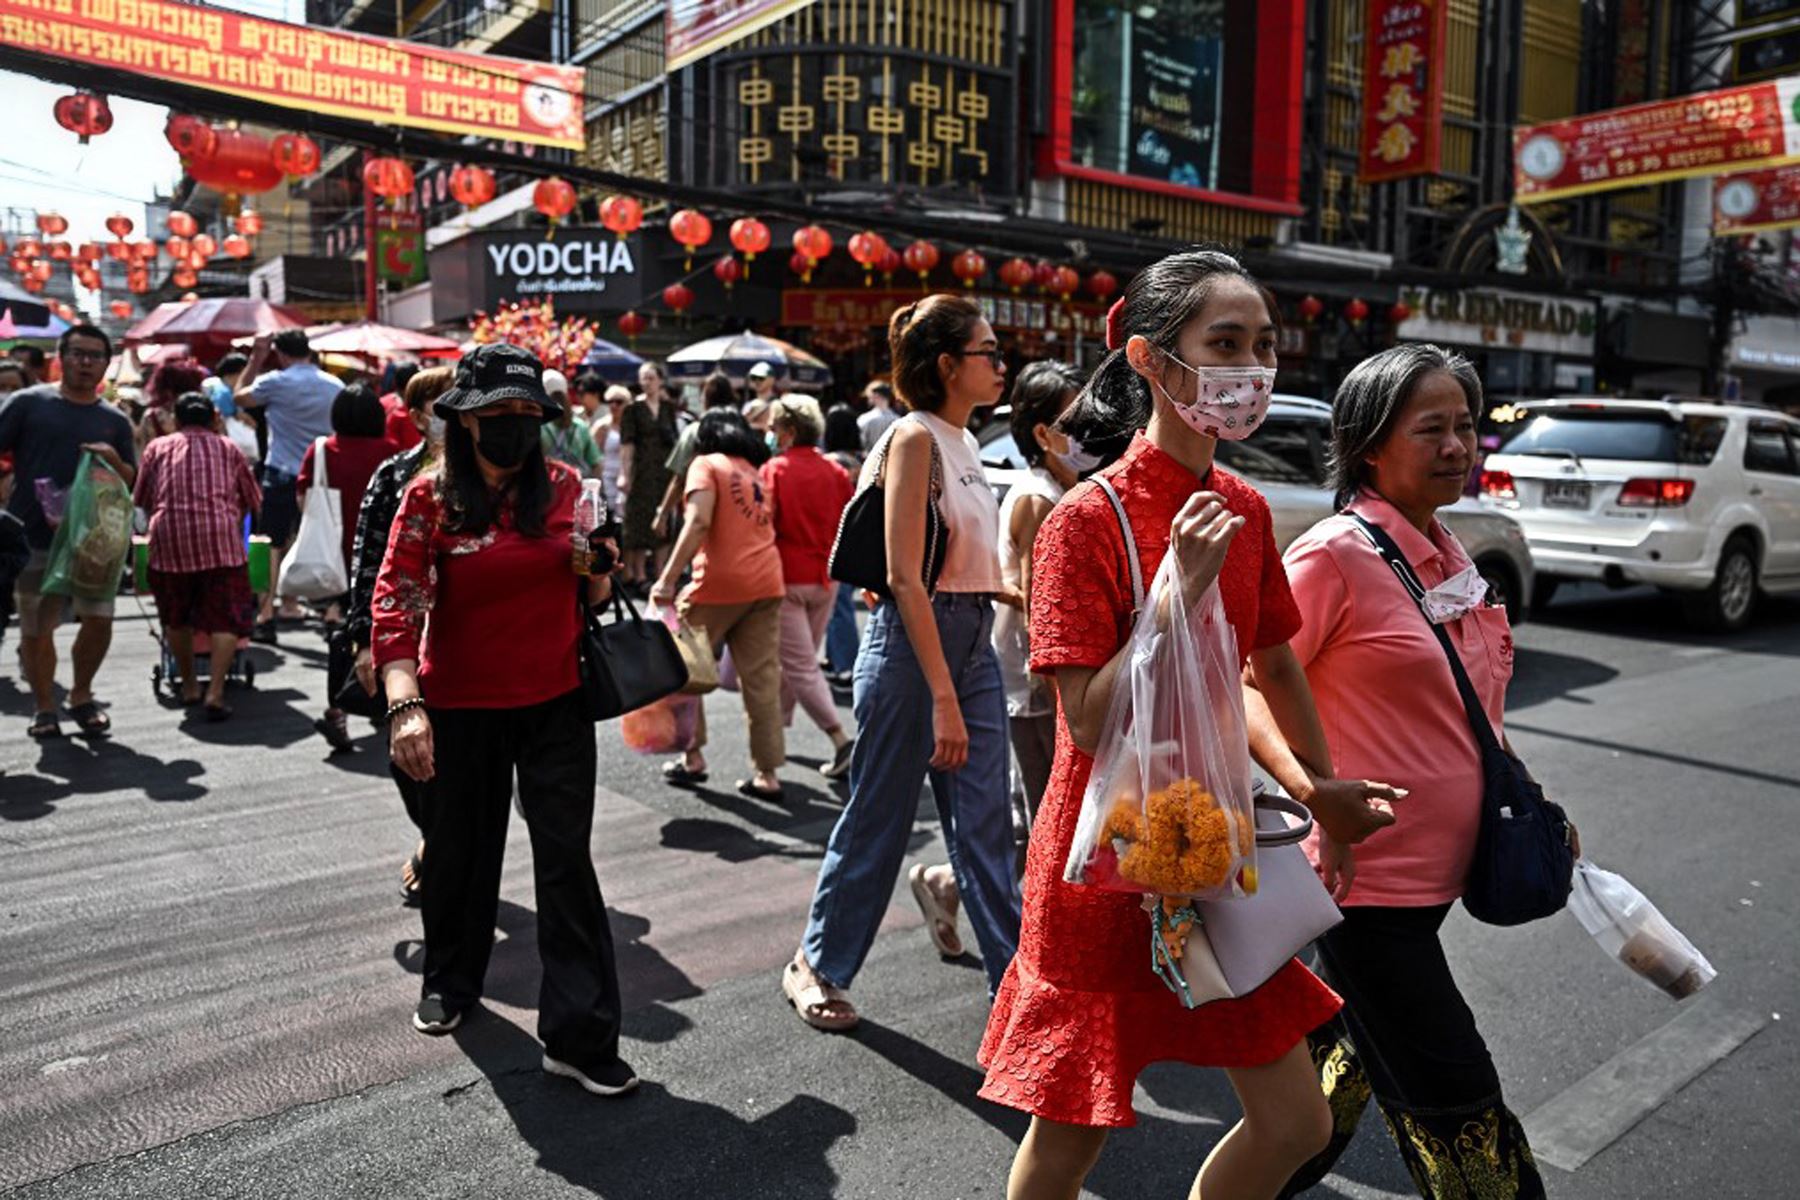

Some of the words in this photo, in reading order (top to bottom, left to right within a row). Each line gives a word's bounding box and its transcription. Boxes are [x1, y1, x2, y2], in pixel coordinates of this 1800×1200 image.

[0, 13, 407, 116] ณะกรรมการศาลเจ้าพ่อกวนอู
[420, 89, 520, 128] เยาวราช
[487, 240, 635, 277] YODCHA
